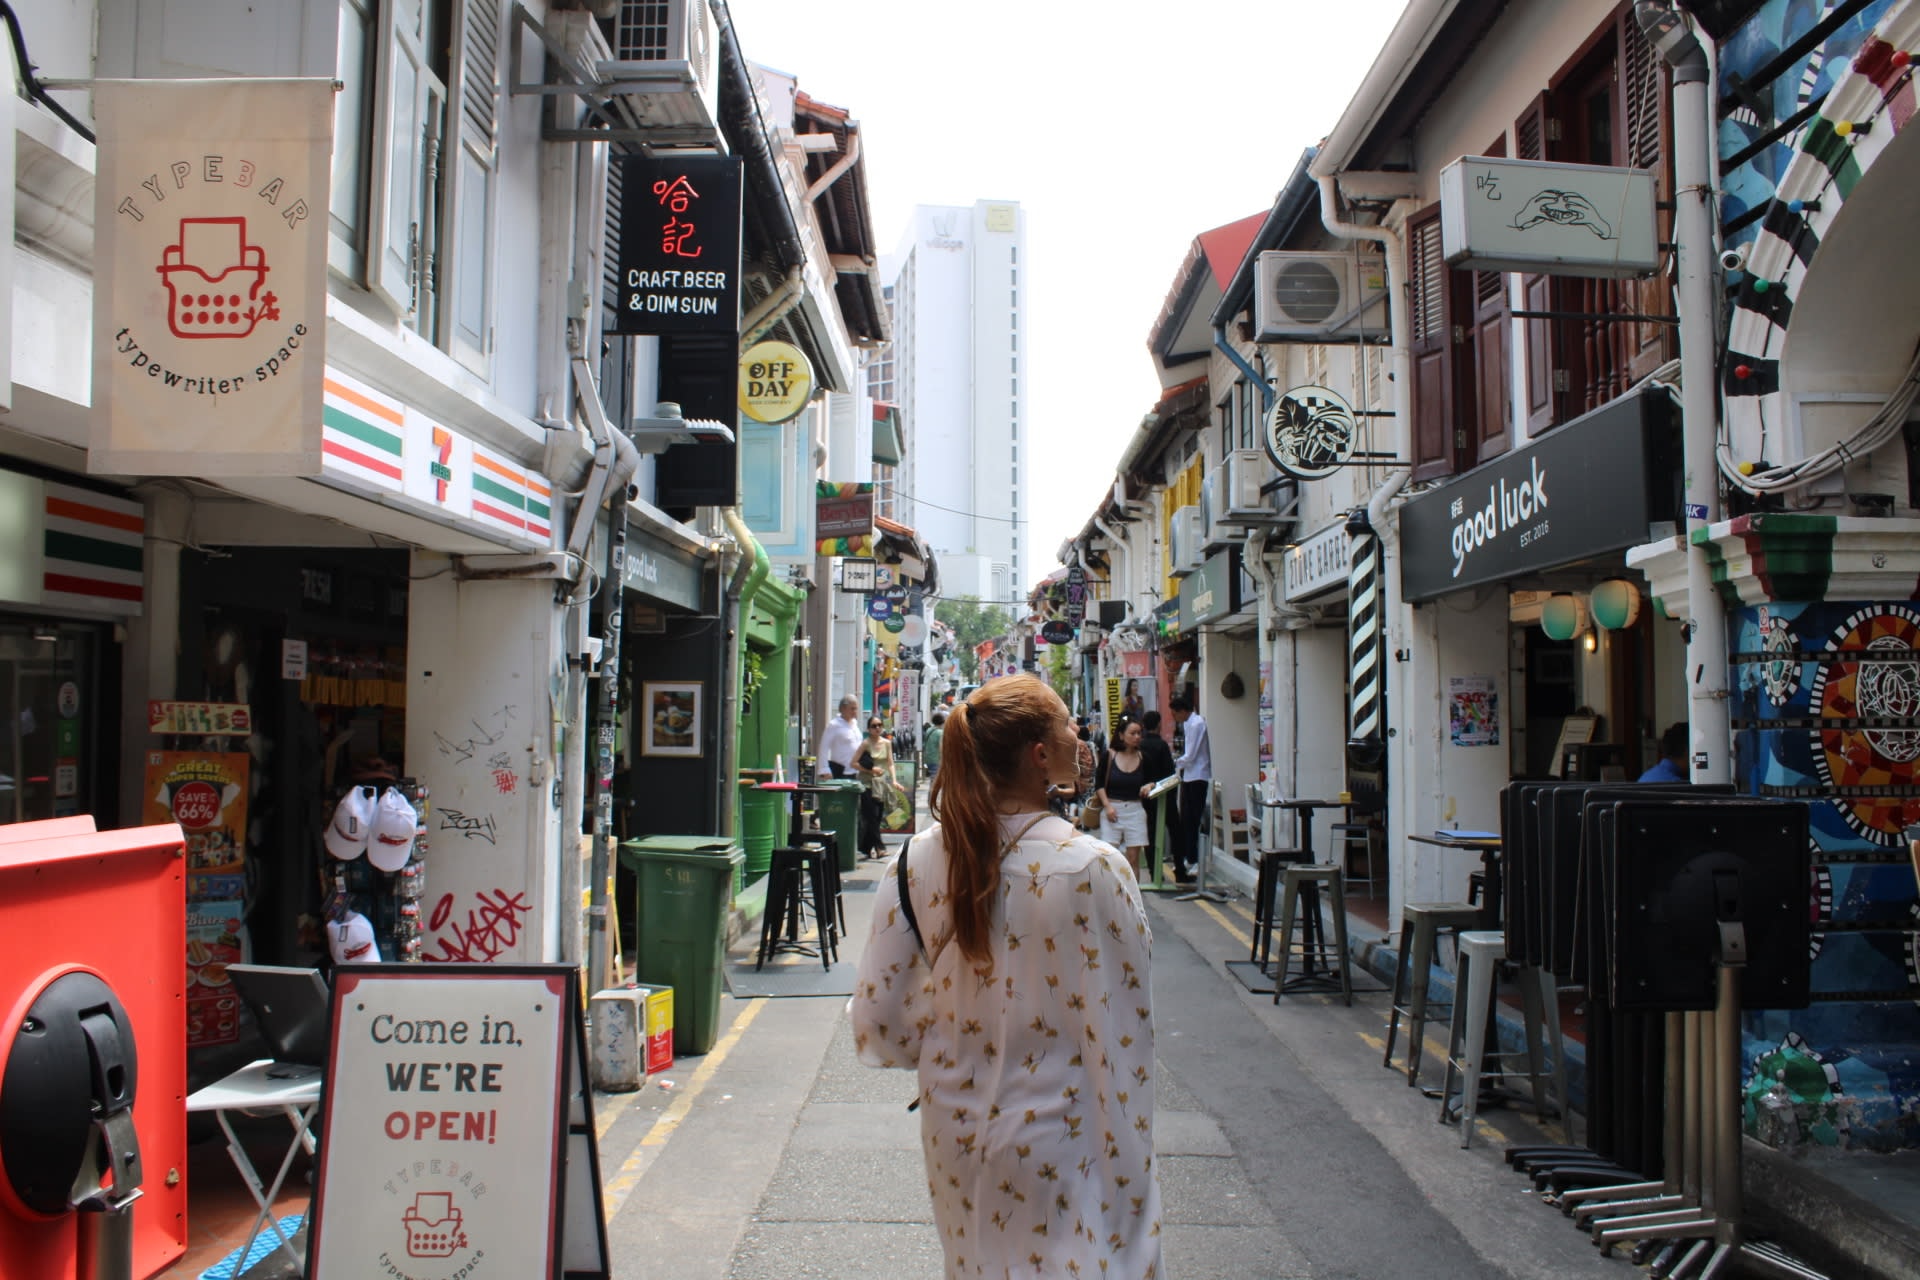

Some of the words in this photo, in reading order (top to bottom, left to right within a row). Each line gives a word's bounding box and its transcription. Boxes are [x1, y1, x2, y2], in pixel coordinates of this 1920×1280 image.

[118, 156, 309, 230] TYPEBAR
[1477, 170, 1502, 201] 吃
[628, 269, 680, 289] CRAFT
[684, 270, 726, 289] BEER
[629, 295, 643, 311] &
[647, 295, 677, 314] DIM
[680, 297, 717, 314] SUM
[115, 327, 244, 395] typewriter
[255, 323, 308, 382] space
[749, 361, 794, 379] OFF
[748, 380, 793, 397] DAY
[1452, 485, 1497, 577] good
[1501, 456, 1549, 532] luck
[1520, 532, 1534, 548] EST.
[1534, 519, 1549, 542] 2016
[1317, 532, 1348, 577] BARBE
[176, 763, 221, 773] GREAT
[178, 793, 208, 803] SAVE
[179, 804, 214, 819] 66%
[371, 1014, 468, 1044] Come
[480, 1014, 523, 1047] in,
[386, 1063, 503, 1092] WE'RE
[384, 1109, 497, 1145] OPEN!
[384, 1159, 488, 1199] TYPEBAR
[452, 1250, 485, 1280] space
